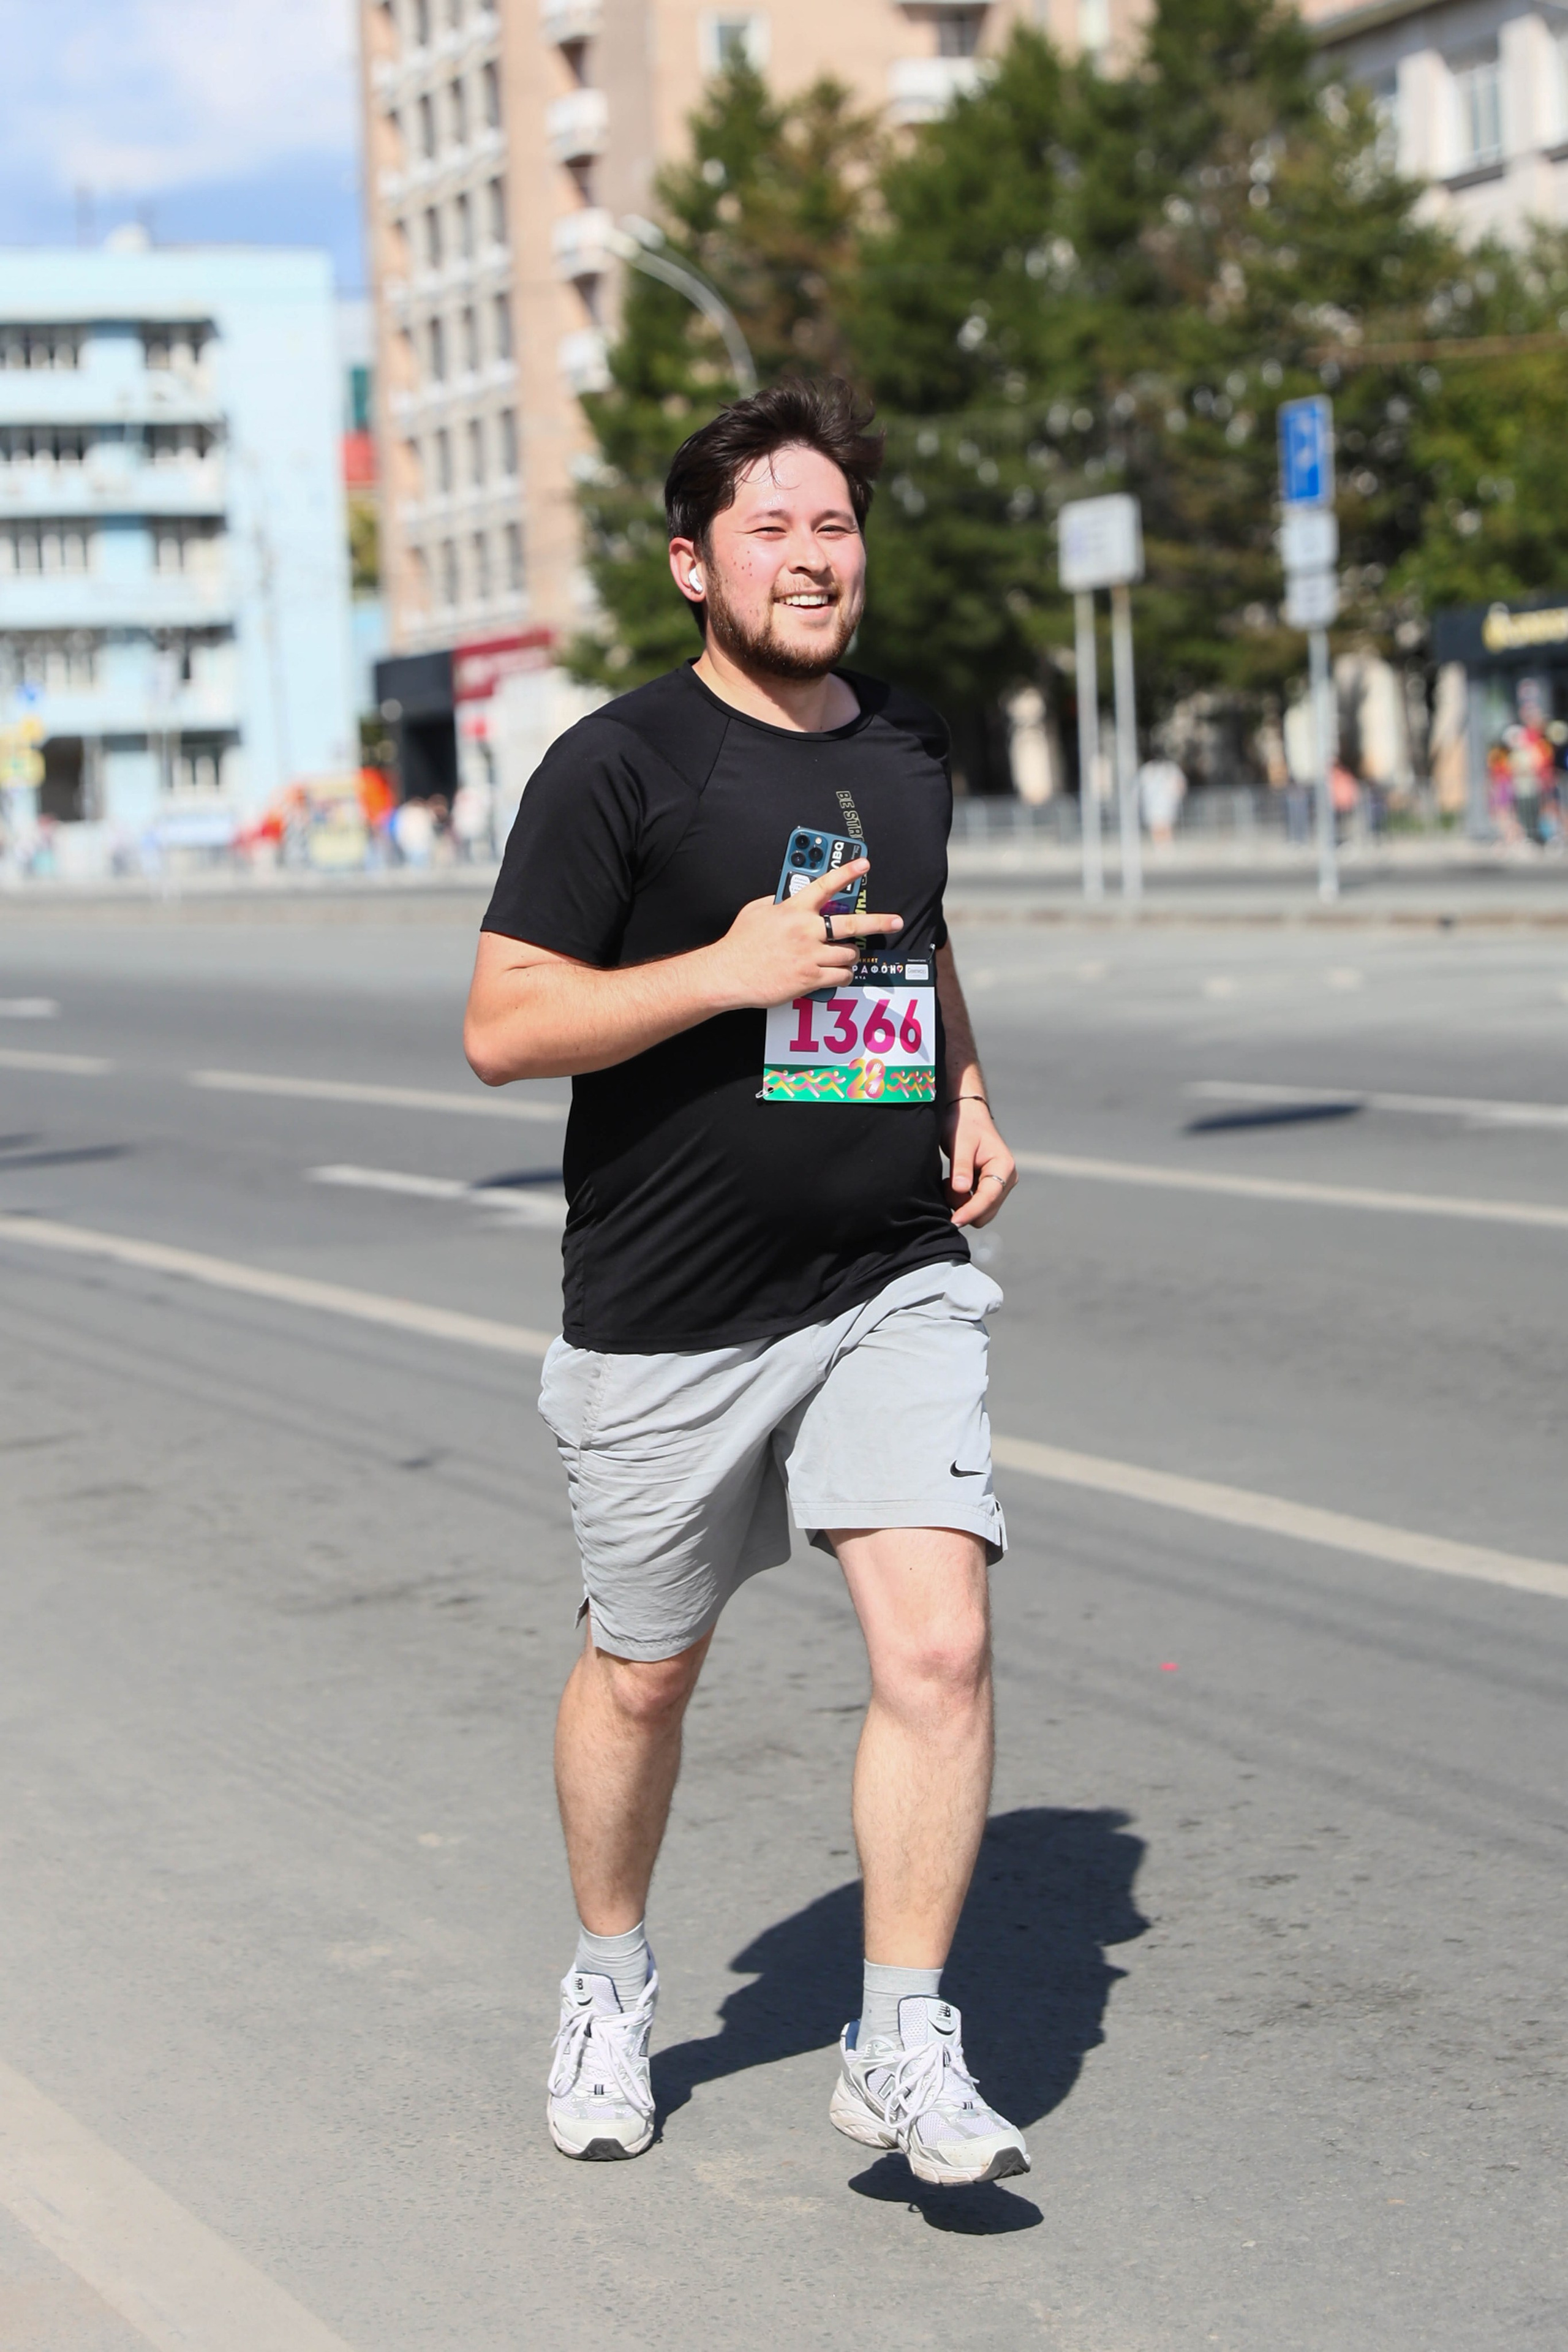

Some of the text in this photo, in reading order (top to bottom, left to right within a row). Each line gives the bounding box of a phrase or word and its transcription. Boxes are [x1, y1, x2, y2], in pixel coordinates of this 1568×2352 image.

[835, 791, 855, 809] BE
[852, 965, 896, 974] РАФОН
[790, 998, 922, 1054] 1366
